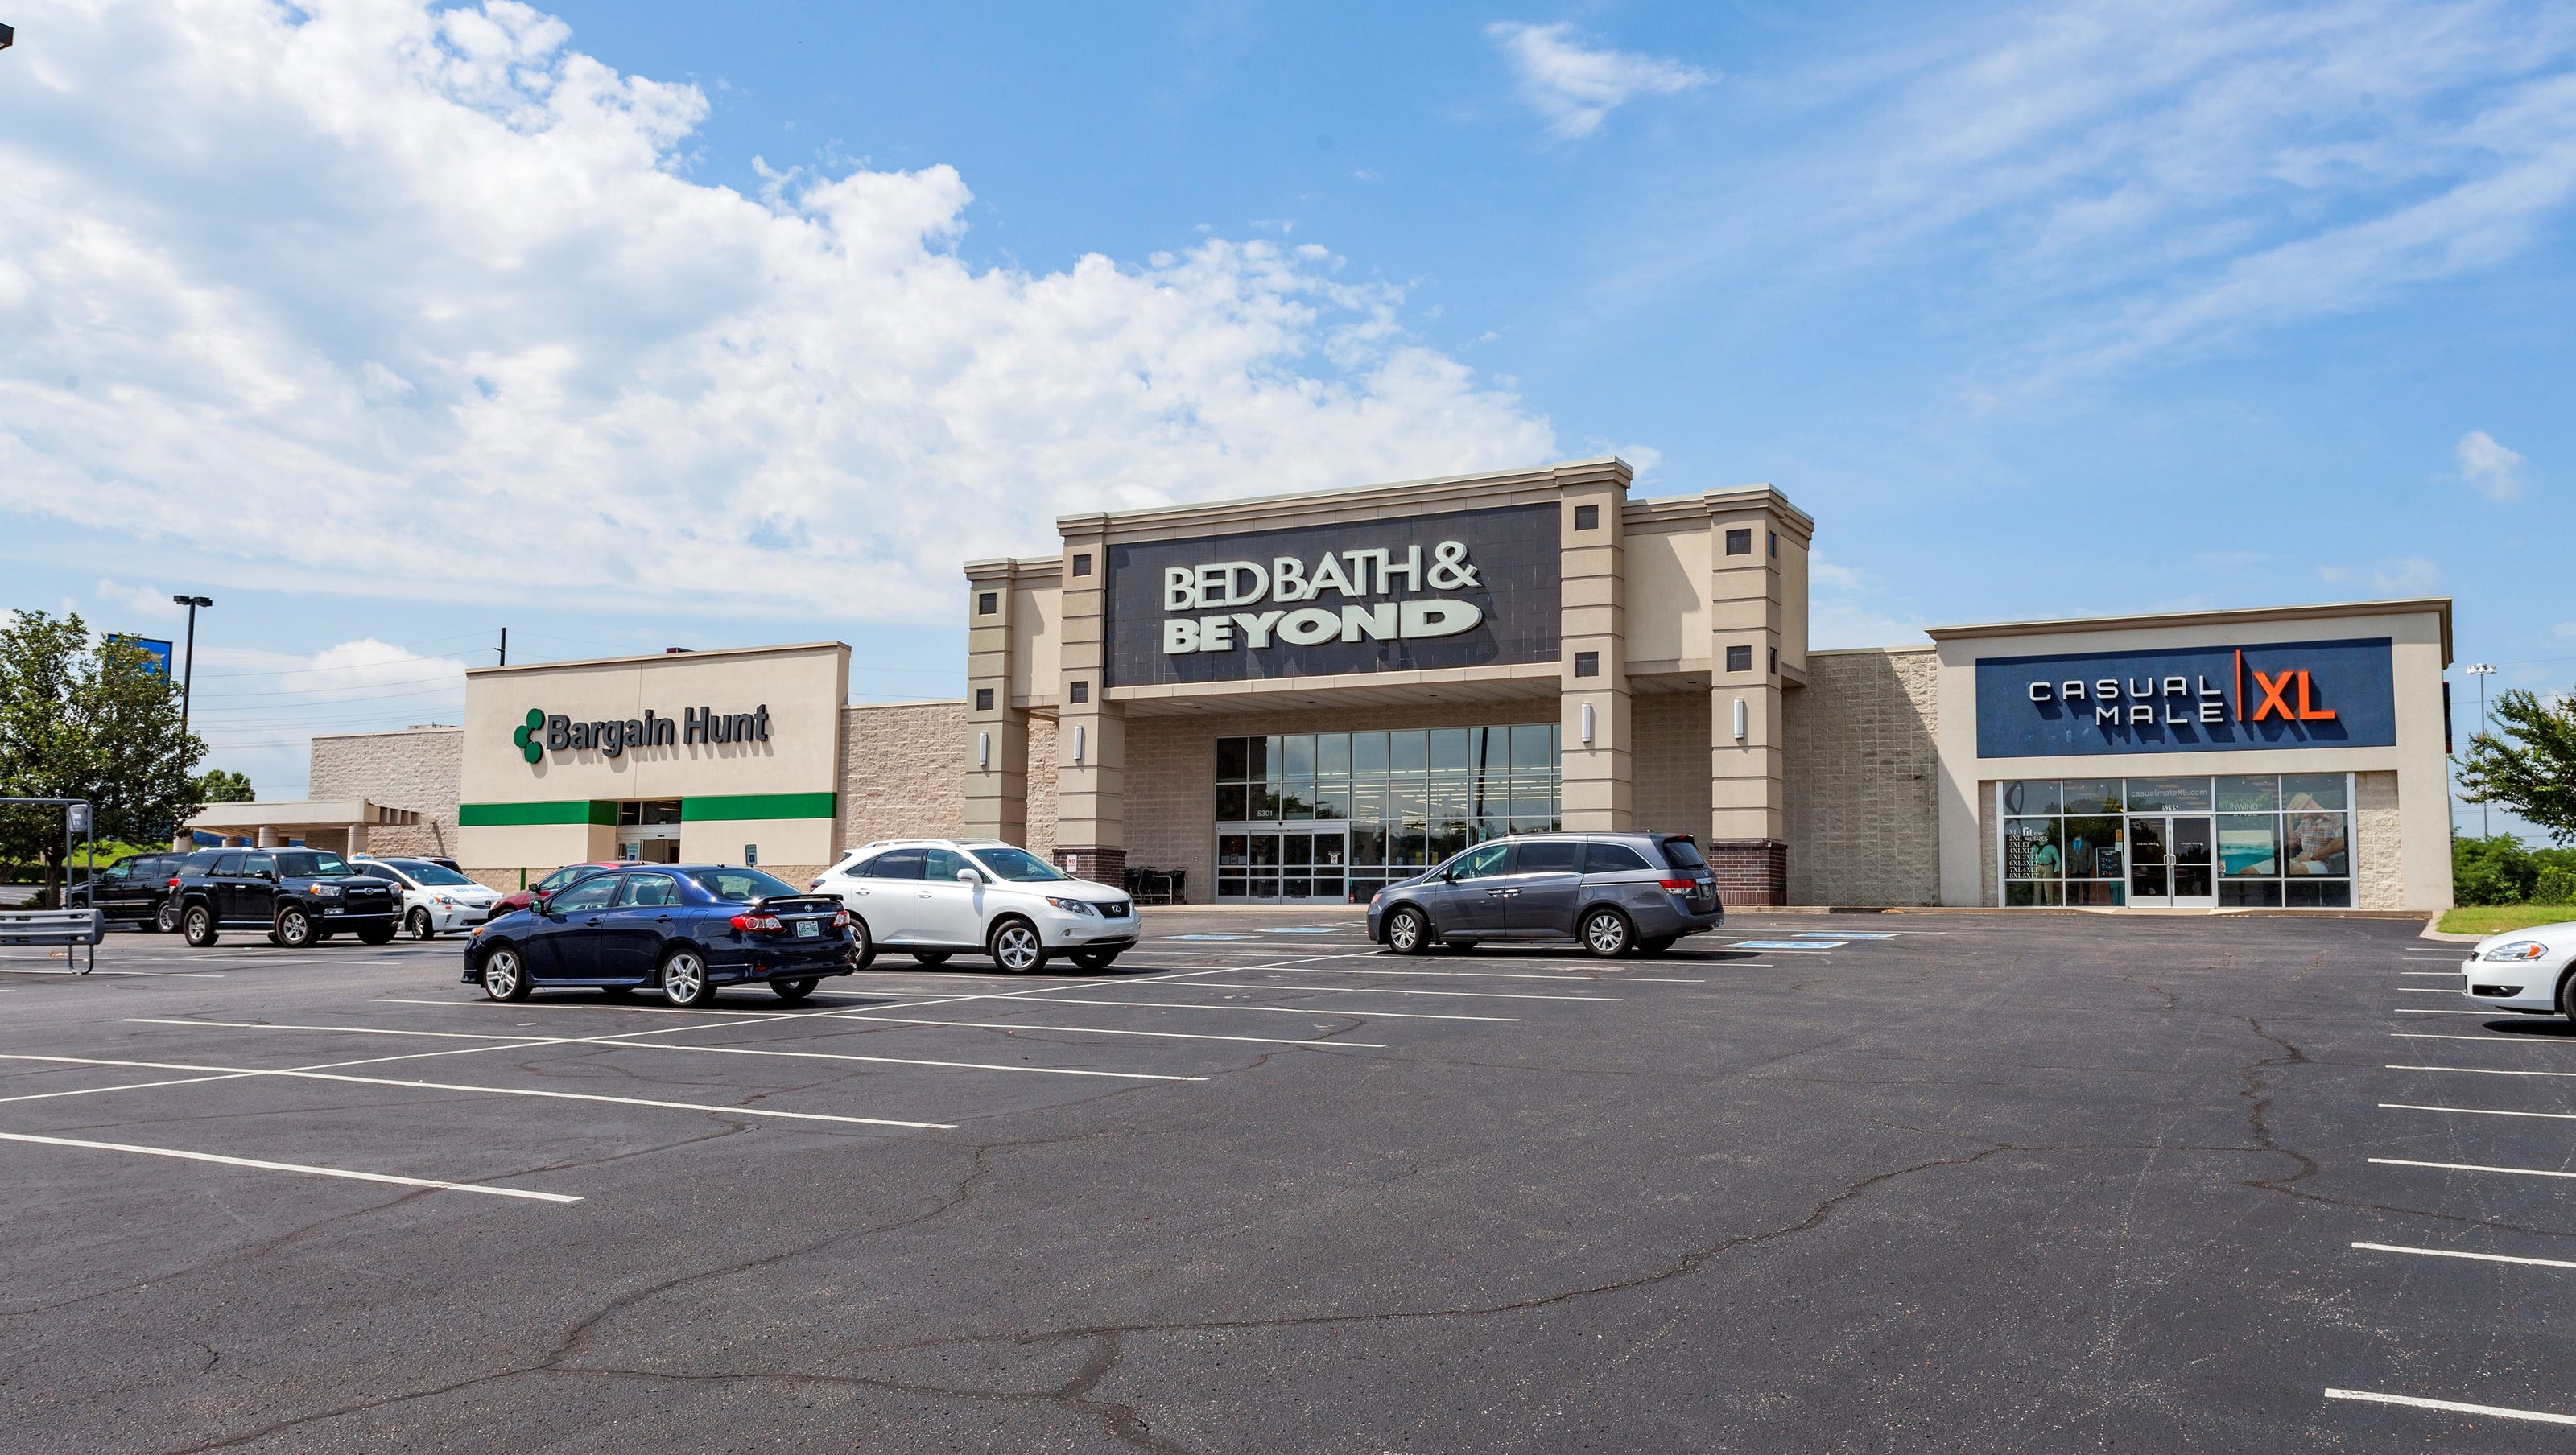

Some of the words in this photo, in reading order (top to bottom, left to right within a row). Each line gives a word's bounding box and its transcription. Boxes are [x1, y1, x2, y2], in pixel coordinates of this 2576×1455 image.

[1164, 560, 1269, 611] BED
[1274, 545, 1421, 602] BATH
[1427, 541, 1482, 590] &
[1164, 599, 1483, 654] BEYOND
[2029, 675, 2221, 701] CASUAL
[2252, 670, 2335, 720] XL
[547, 709, 675, 757] Bargain
[683, 704, 769, 744] Hunt
[2096, 702, 2223, 725] MALE
[2131, 789, 2208, 798] casualmaleXL.com
[2022, 827, 2033, 836] fit
